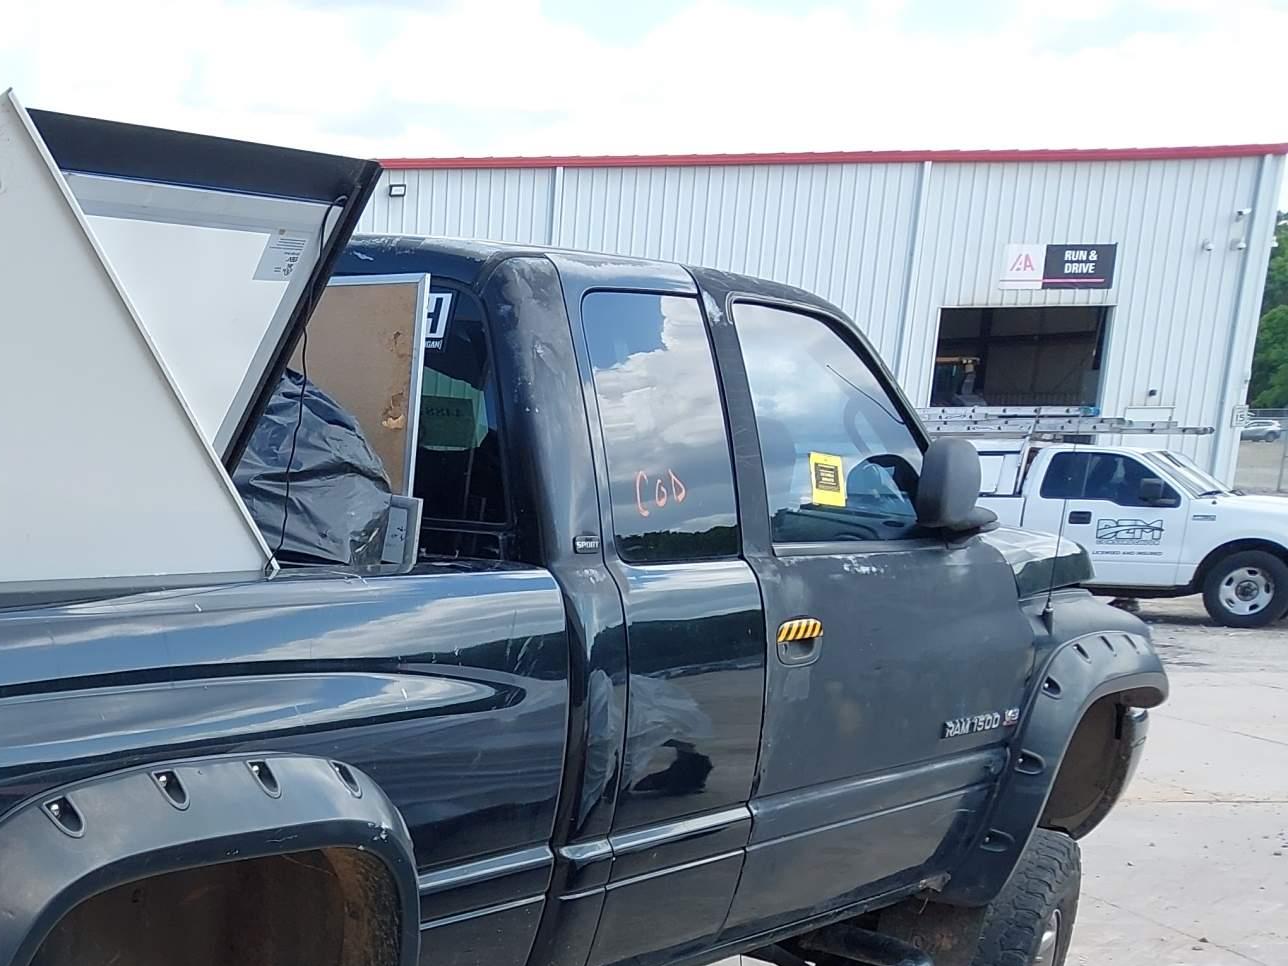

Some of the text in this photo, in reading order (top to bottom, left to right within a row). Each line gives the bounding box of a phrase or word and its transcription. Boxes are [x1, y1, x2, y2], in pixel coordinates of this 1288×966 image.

[1064, 250, 1098, 261] RUN &
[1064, 263, 1096, 274] DRIVE
[576, 541, 599, 549] SPORT
[945, 719, 971, 738] RAM
